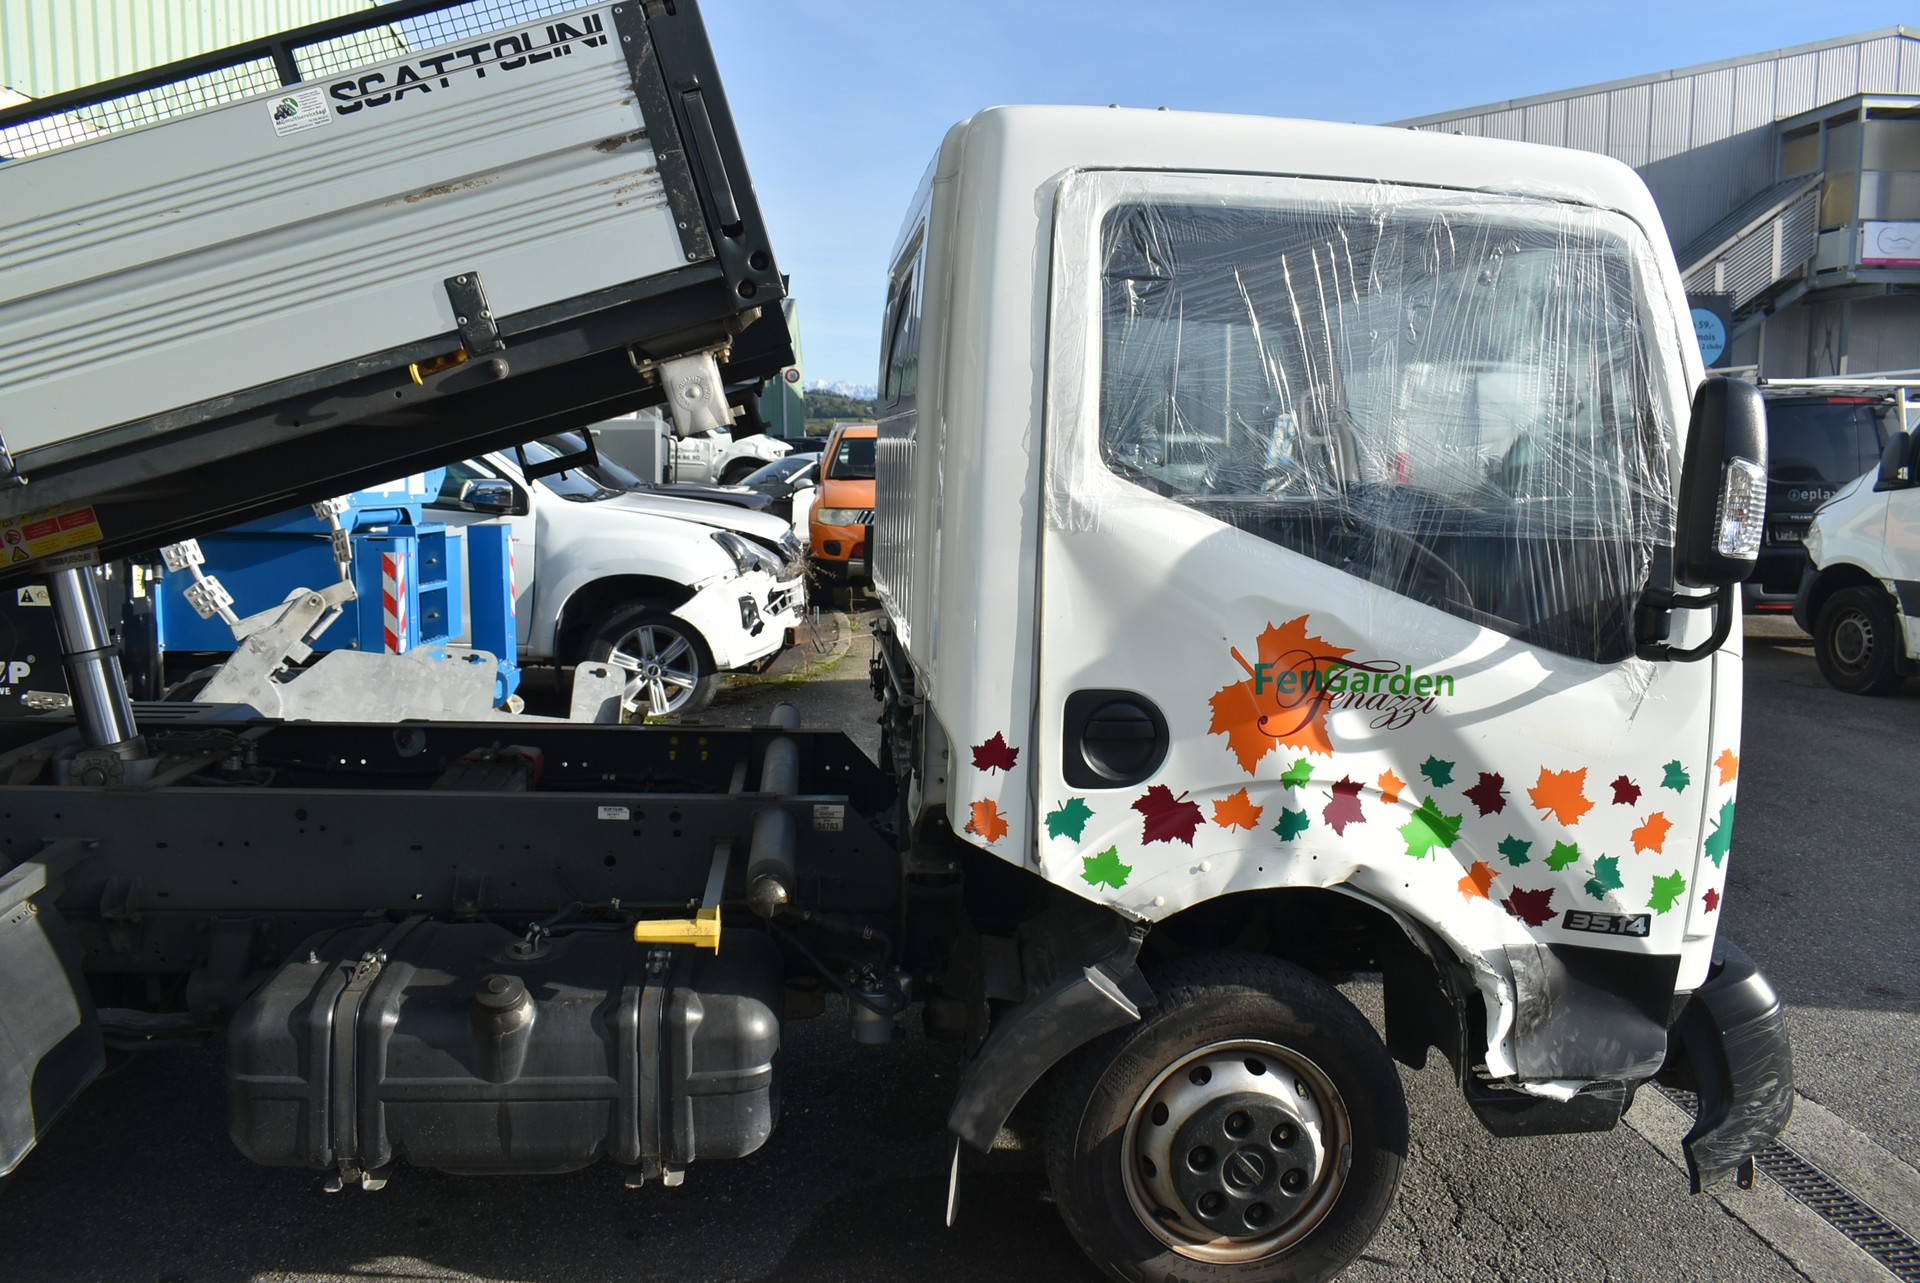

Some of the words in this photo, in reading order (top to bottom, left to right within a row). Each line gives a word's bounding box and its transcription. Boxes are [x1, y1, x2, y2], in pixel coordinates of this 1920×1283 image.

[329, 13, 608, 116] SCATTOLINI
[678, 375, 704, 389] QUALITY
[1254, 662, 1455, 697] FenGarden
[1257, 649, 1439, 738] Fenazzi
[1569, 913, 1647, 935] 35.14
